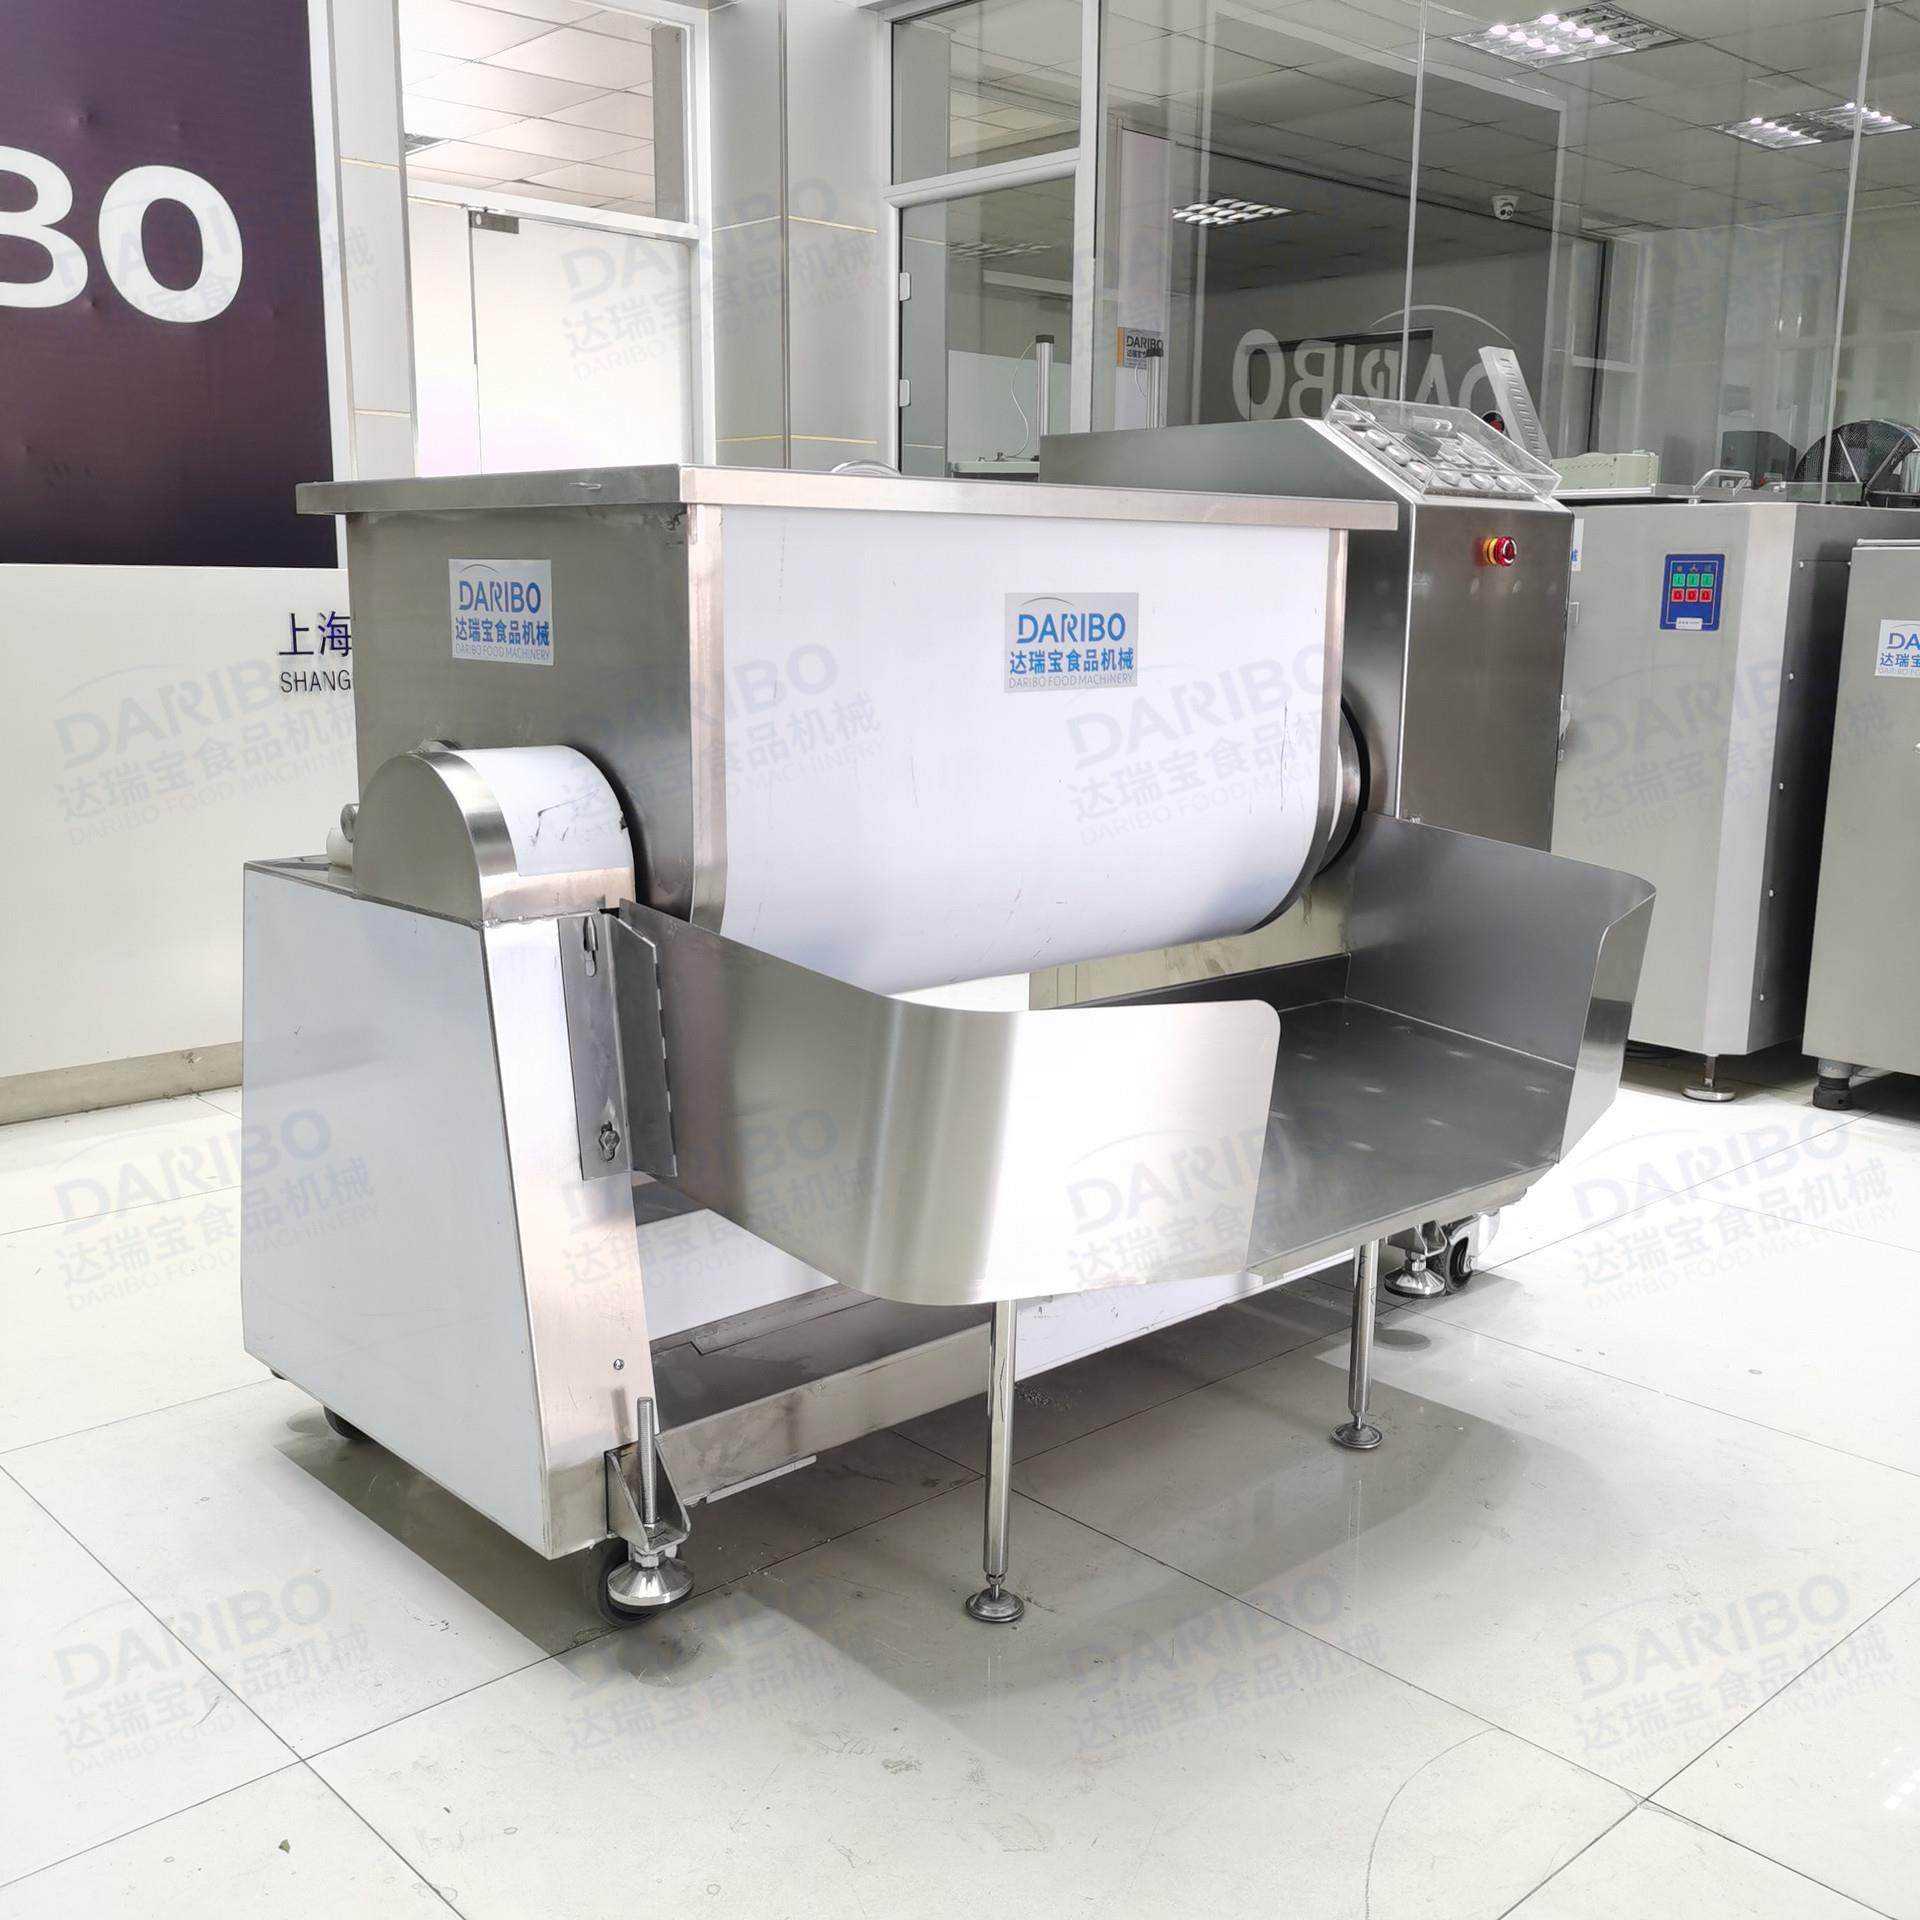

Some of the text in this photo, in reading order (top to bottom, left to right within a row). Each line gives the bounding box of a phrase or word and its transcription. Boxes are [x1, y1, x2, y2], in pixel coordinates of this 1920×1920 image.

[459, 580, 541, 614] DARIBO
[278, 611, 352, 657] 上海
[455, 615, 550, 646] 达瑞宝食品机械
[1016, 612, 1126, 643] DARIBO
[1887, 632, 1920, 650] DA
[483, 645, 504, 657] FOOD
[1009, 647, 1134, 674] 达瑞宝食品机械
[280, 669, 351, 693] SHANG
[1009, 672, 1133, 688] DARIBO FOOD MACHINERY
